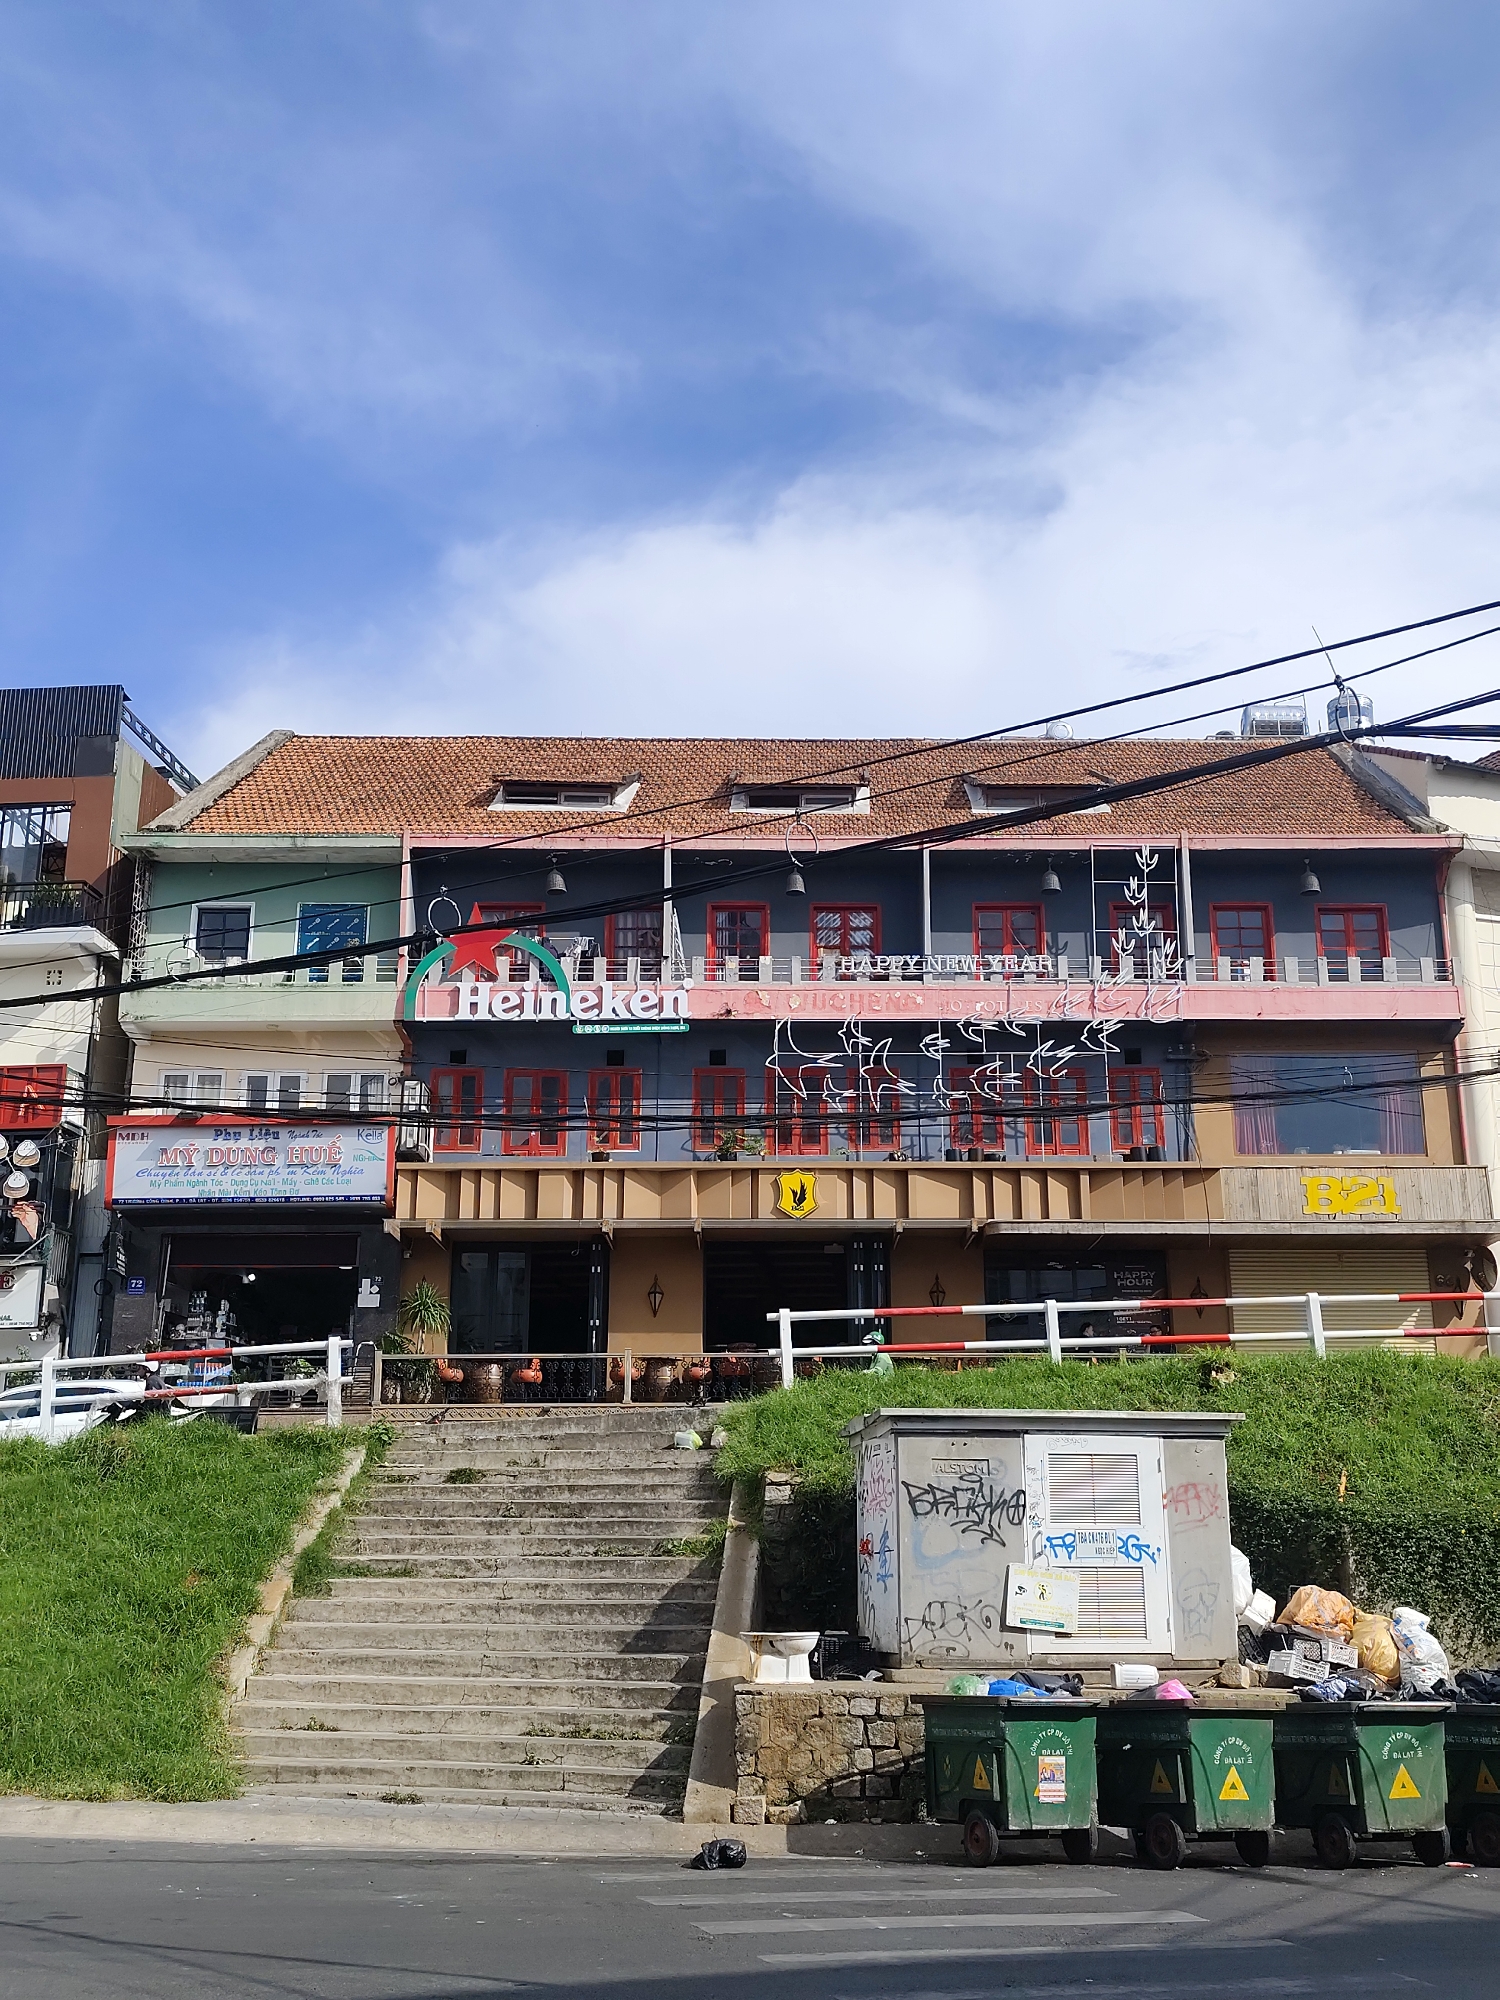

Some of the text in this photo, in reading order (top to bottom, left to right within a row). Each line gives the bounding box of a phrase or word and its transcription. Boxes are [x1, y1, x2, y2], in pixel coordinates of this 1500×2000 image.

[838, 955, 1053, 973] HAPPY NEW YEAR
[454, 981, 692, 1020] Heineken
[118, 1132, 149, 1142] MDH
[213, 1128, 242, 1144] Phụ
[248, 1127, 280, 1144] Liệu
[357, 1128, 383, 1142] Kella
[206, 1146, 278, 1167] DUNG
[286, 1134, 344, 1166] HUẾ
[136, 1167, 180, 1180] Chuyên
[183, 1167, 204, 1177] bán
[220, 1166, 229, 1177] &
[329, 1163, 365, 1178] Nghĩa
[211, 1178, 224, 1187] Tóc
[230, 1178, 248, 1188] Dụng
[282, 1178, 298, 1188] Máy
[1300, 1176, 1402, 1216] B21
[1113, 1271, 1156, 1279] HAPPY
[130, 1279, 143, 1288] 72
[1117, 1278, 1153, 1287] HOUR
[934, 1462, 986, 1475] ALSTOM
[1030, 1738, 1041, 1757] CÔNG
[1047, 1728, 1055, 1736] CP
[1041, 1747, 1051, 1756] ĐÀ
[1213, 1746, 1224, 1765] CÔNG
[1393, 1751, 1402, 1760] ĐÀ
[1224, 1755, 1233, 1765] ĐÀ
